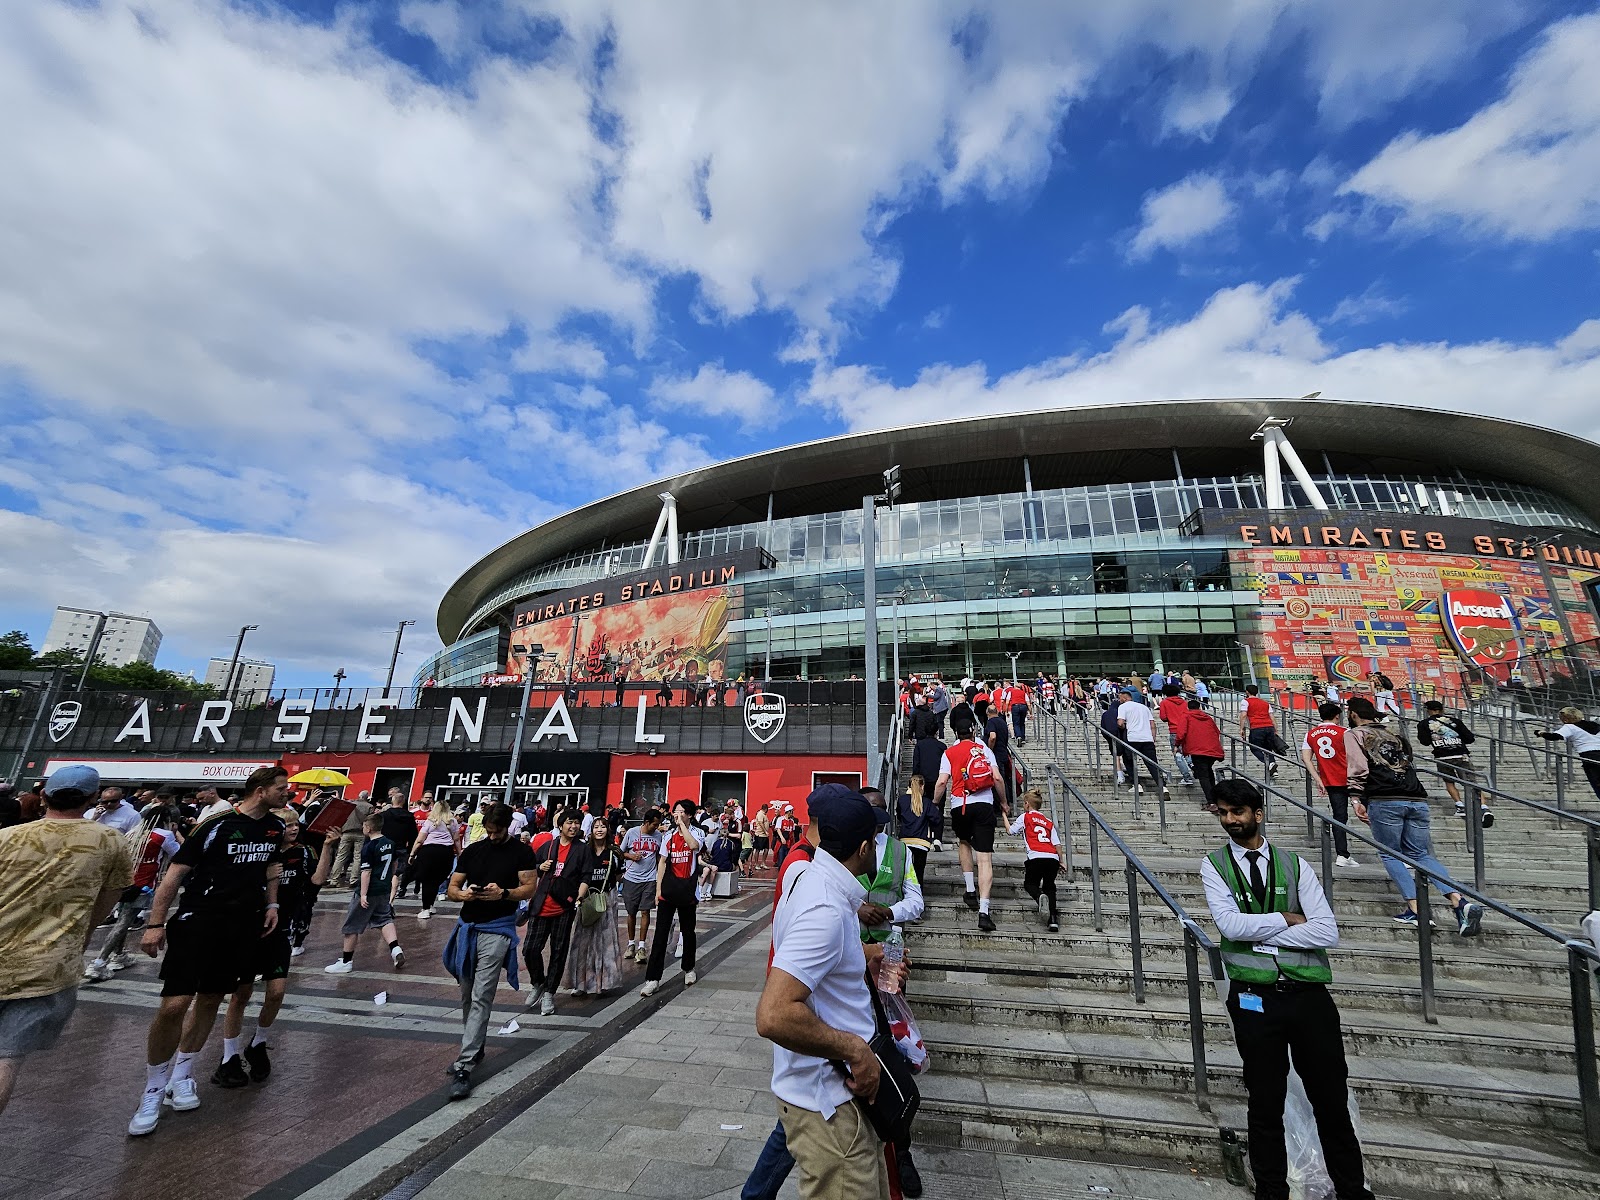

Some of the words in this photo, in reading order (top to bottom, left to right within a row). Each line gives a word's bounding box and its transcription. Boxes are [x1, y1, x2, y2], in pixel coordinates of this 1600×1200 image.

[1240, 525, 1447, 550] EMIRATES
[1272, 563, 1295, 573] ARSENAL
[1393, 567, 1438, 580] Arsenal
[1442, 569, 1471, 579] ARSENAL
[1471, 571, 1502, 581] MALDIVES
[516, 592, 604, 627] EMIRATES
[621, 565, 736, 601] STADIUM
[1453, 601, 1513, 619] Arsenal
[748, 702, 781, 712] Arsenal
[114, 694, 665, 744] ARSENAL
[1316, 736, 1336, 759] 8
[202, 765, 223, 777] BOX
[223, 766, 255, 777] OFFICE
[447, 773, 482, 787] THE
[487, 773, 582, 787] ARMOURY
[1033, 826, 1051, 843] 2
[227, 841, 277, 855] Emirates
[232, 854, 247, 863] FLY
[247, 852, 271, 862] BETTER
[380, 853, 392, 881] 7
